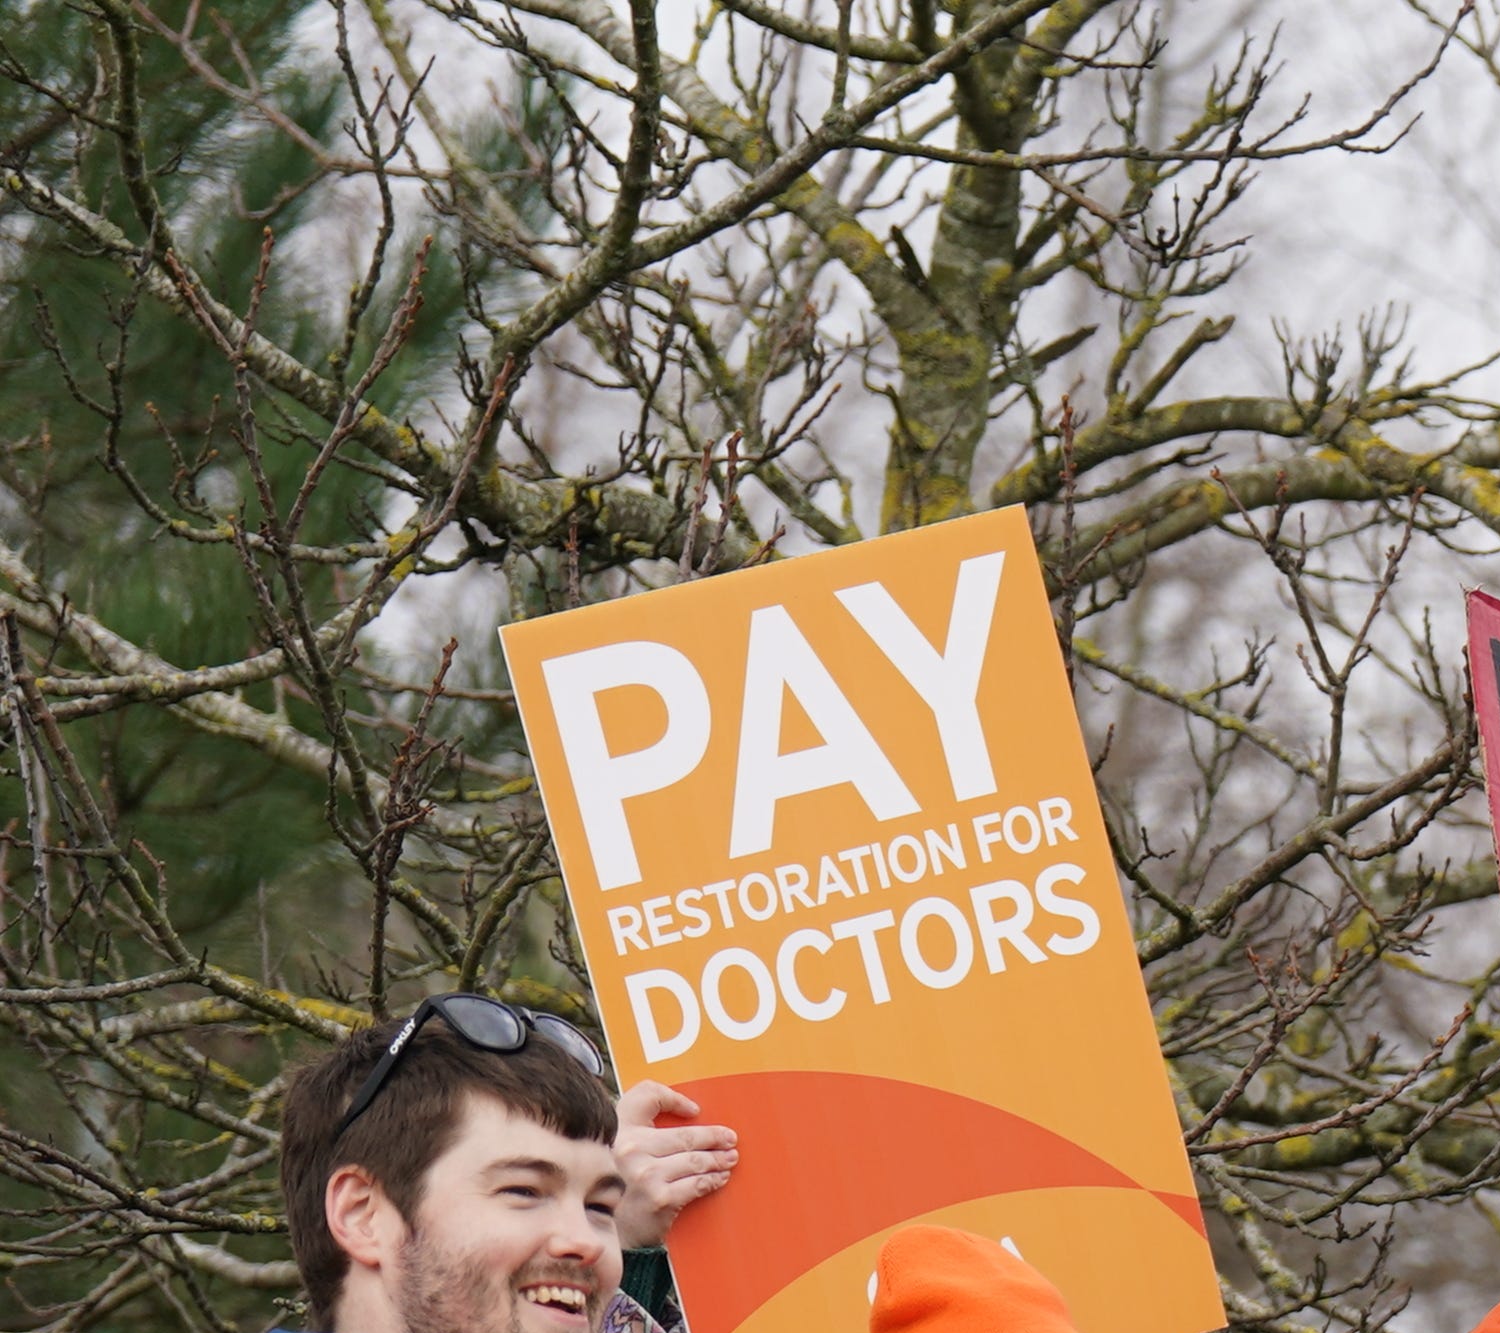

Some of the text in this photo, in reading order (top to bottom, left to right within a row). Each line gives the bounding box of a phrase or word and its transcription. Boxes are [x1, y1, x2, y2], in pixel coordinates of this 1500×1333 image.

[540, 550, 1006, 891] PAY
[606, 796, 1079, 956] RESTORATION FOR
[623, 862, 1101, 1064] DOCTORS
